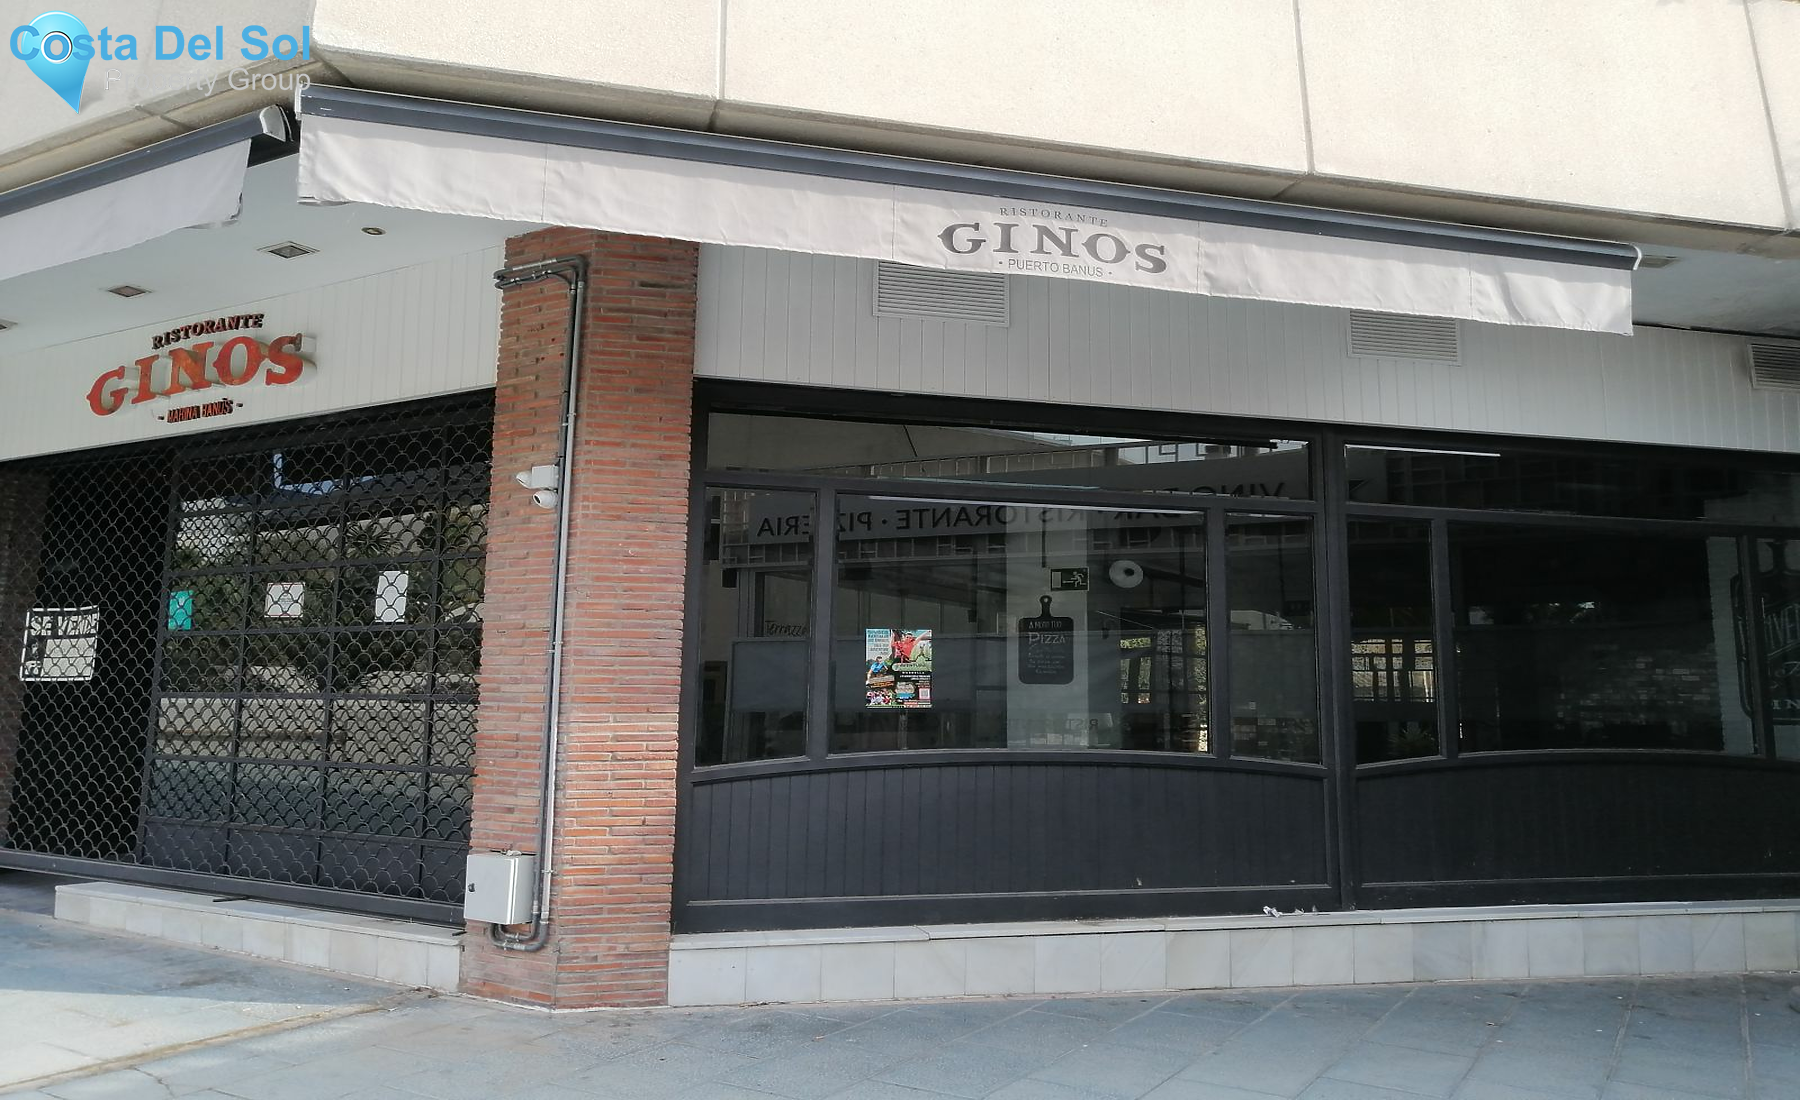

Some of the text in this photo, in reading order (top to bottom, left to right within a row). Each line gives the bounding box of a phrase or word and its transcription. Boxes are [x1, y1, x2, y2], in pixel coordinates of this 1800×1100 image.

[1000, 207, 1108, 228] RISTORANTE
[937, 222, 1167, 274] GINOS
[1008, 258, 1104, 278] PUERTO BANUS
[151, 313, 265, 350] RISTORANTE
[86, 333, 305, 416] GINOS
